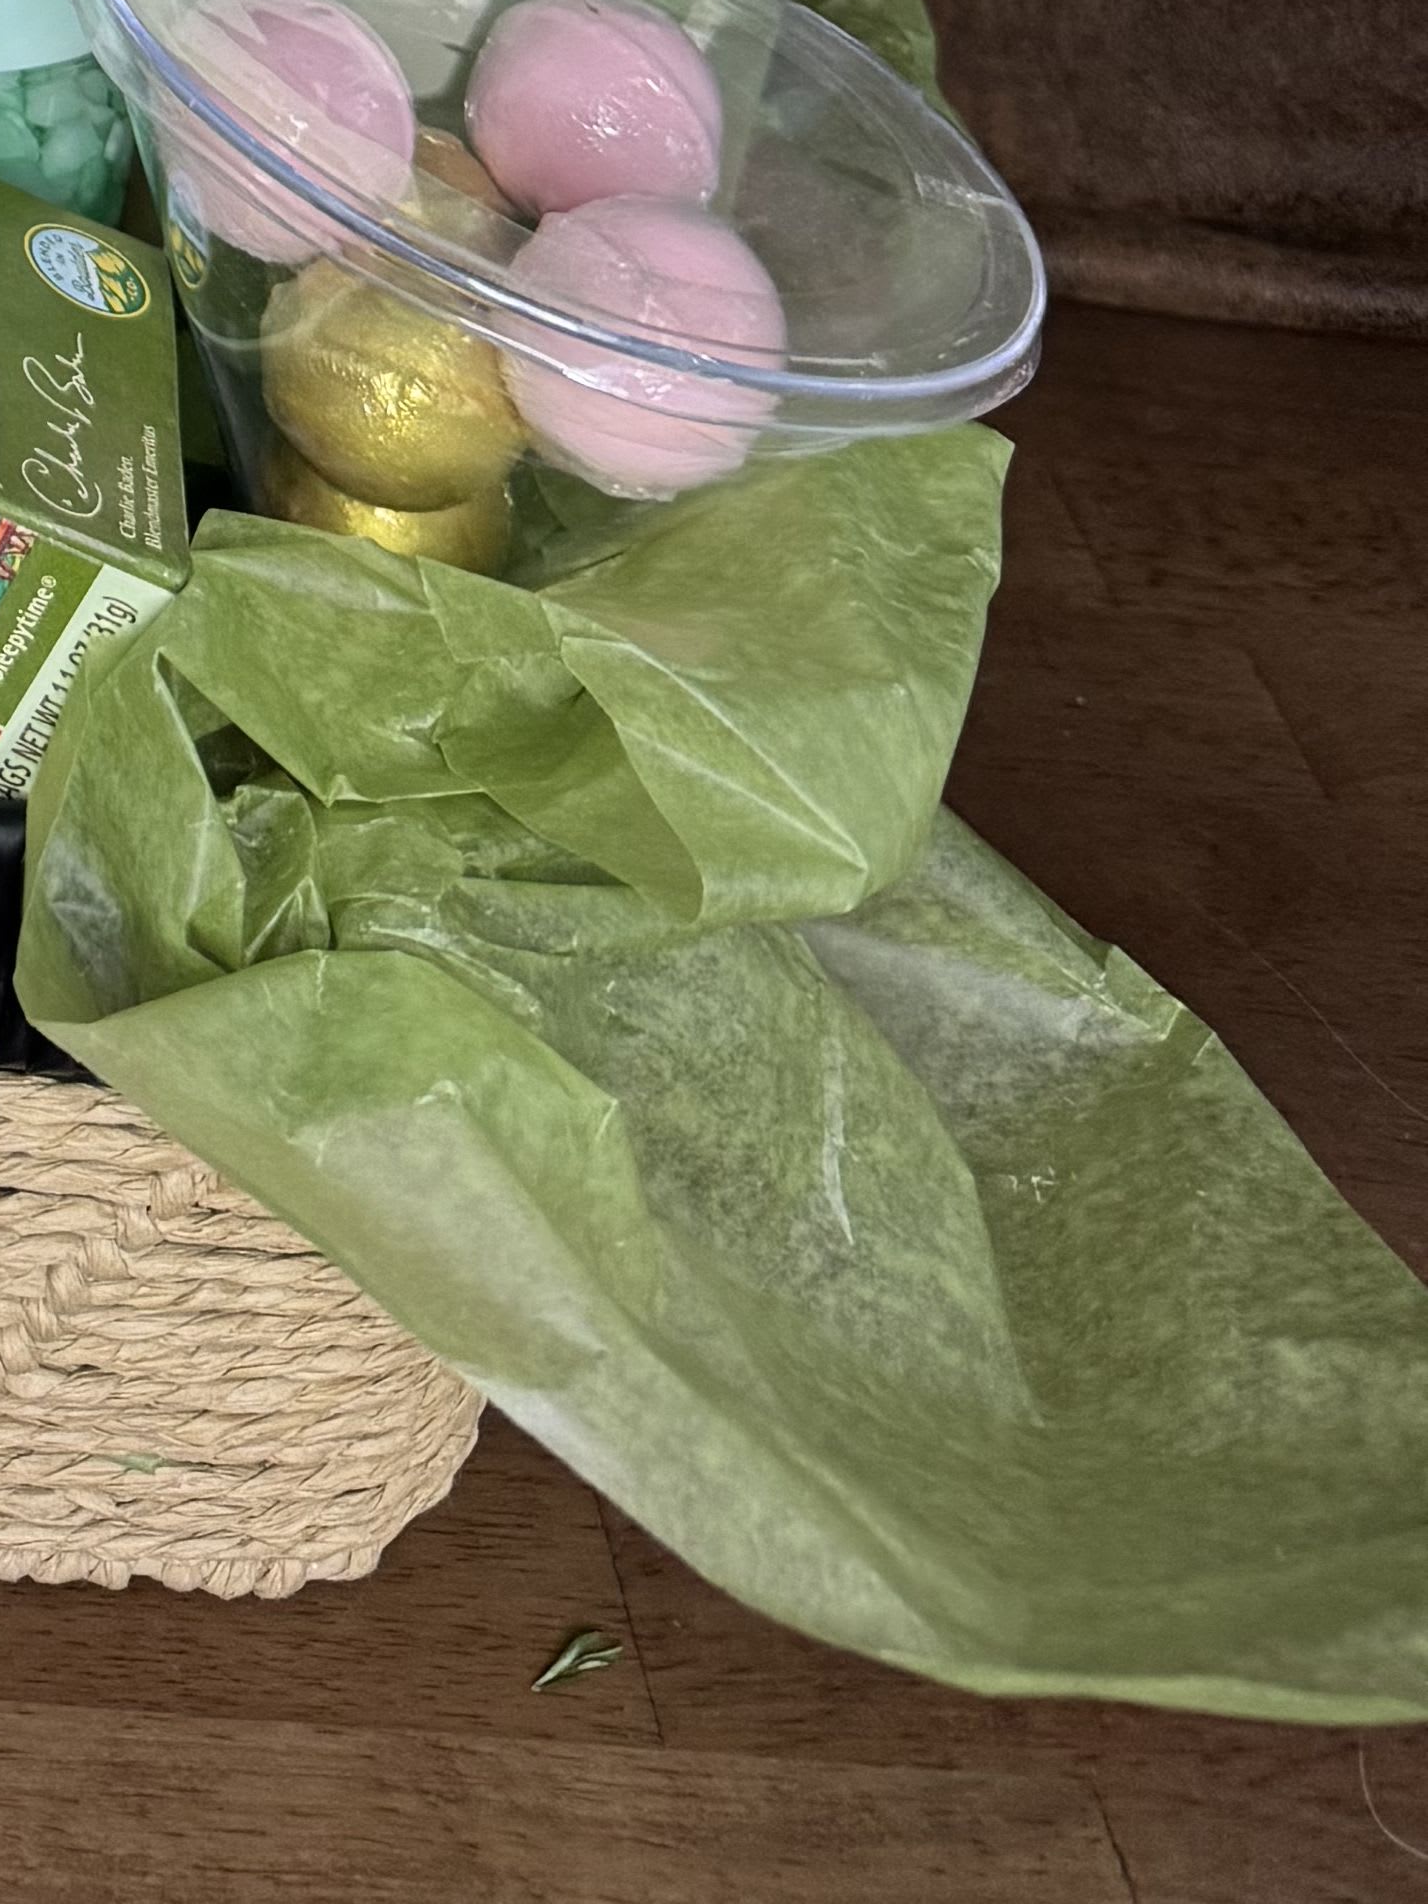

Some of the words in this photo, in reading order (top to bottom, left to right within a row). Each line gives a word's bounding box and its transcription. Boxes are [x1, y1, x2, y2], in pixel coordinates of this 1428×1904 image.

[117, 456, 135, 494] Baden
[118, 495, 137, 538] Charlie
[142, 476, 162, 551] Blendmaster
[11, 725, 50, 765] NET
[38, 694, 61, 729] WT
